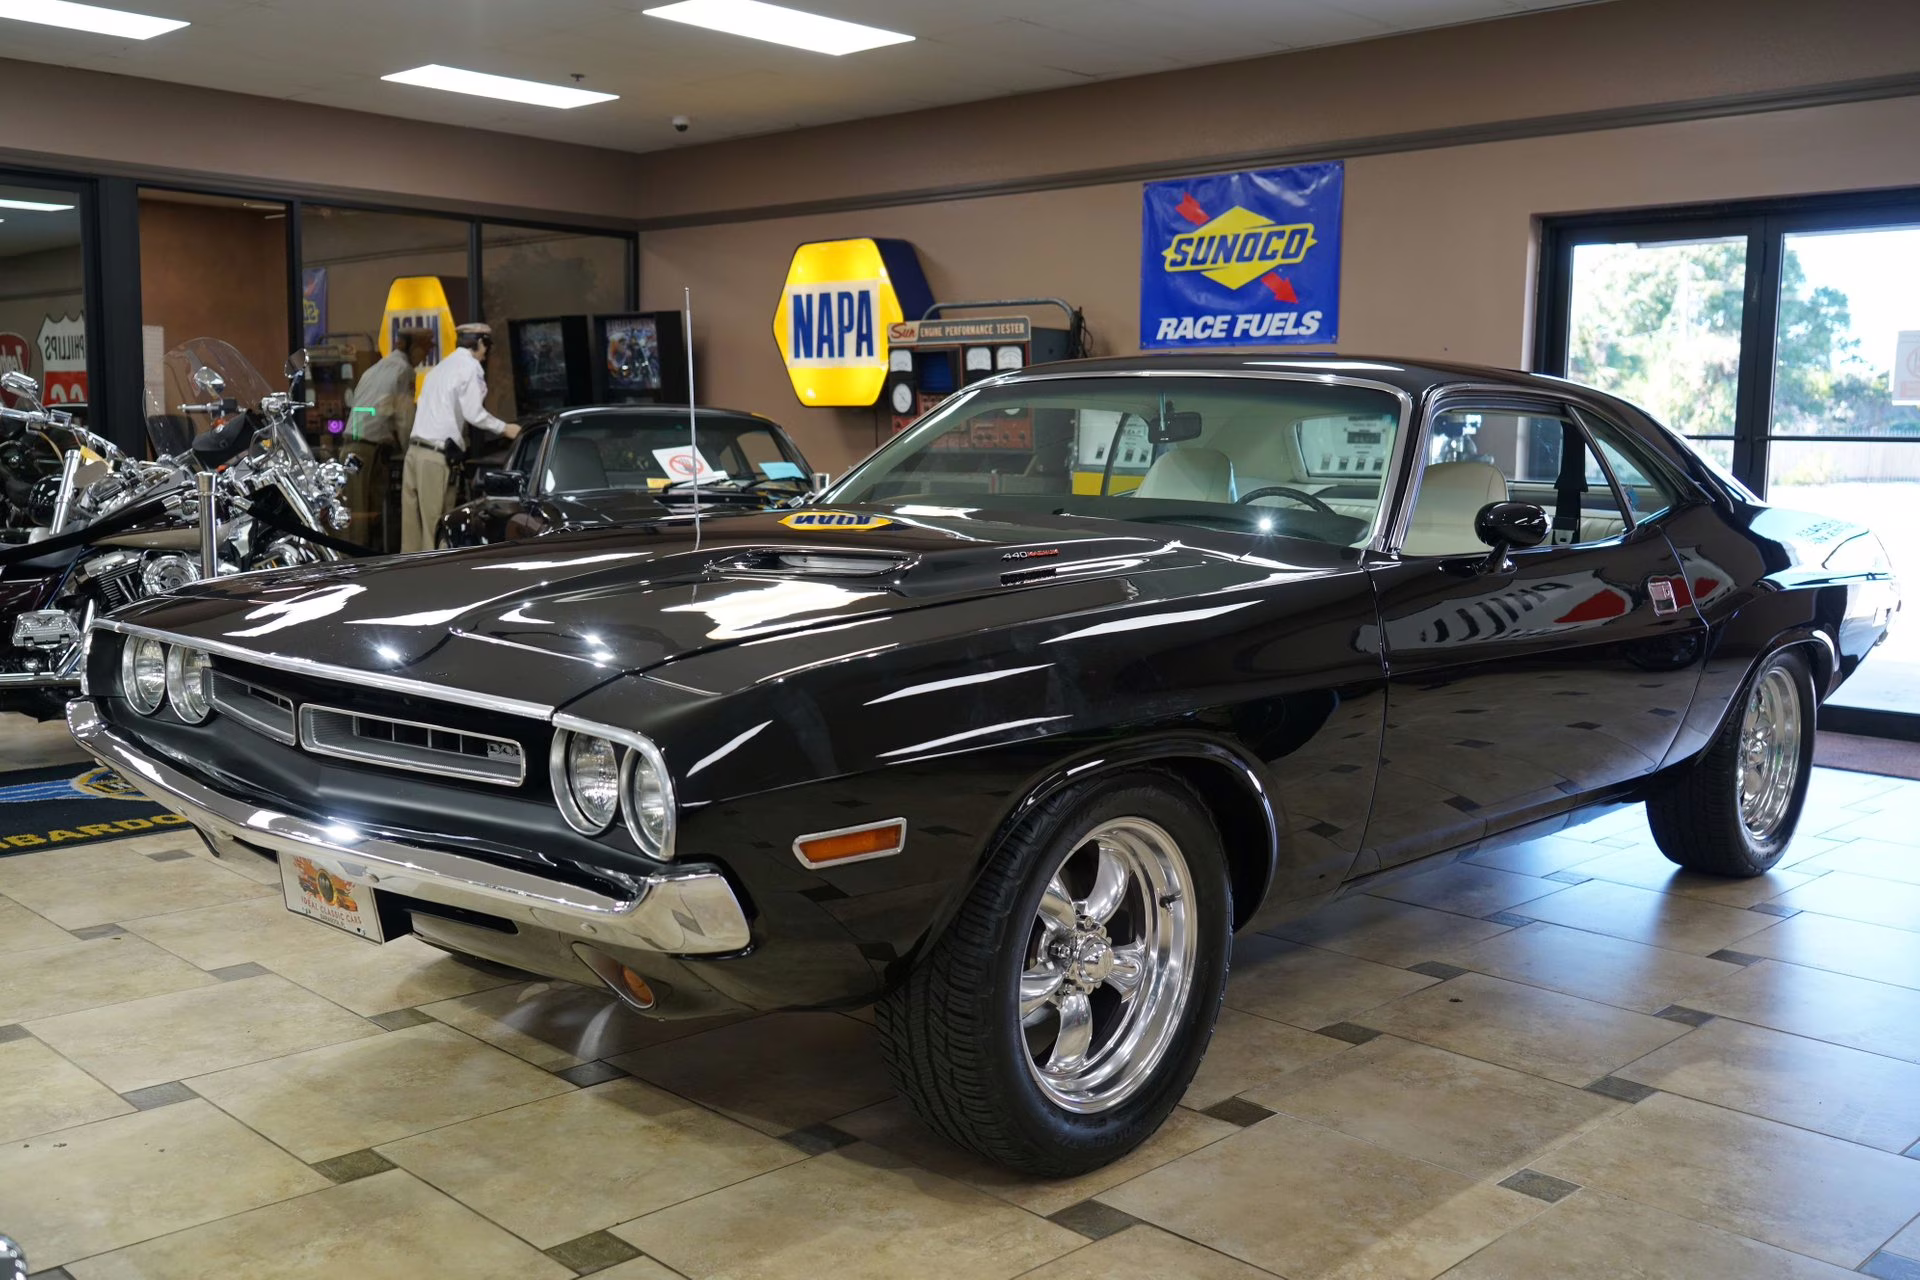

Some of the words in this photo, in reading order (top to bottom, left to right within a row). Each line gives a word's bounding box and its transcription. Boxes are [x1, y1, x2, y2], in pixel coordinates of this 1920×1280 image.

[1168, 228, 1310, 267] SUNOCO
[792, 290, 874, 359] NAPA
[920, 327, 943, 338] ENGINE
[944, 325, 993, 337] PERFORMANCE
[996, 322, 1025, 335] TESTER
[1155, 315, 1232, 340] RACE
[1232, 310, 1322, 338] FUELS
[1001, 550, 1028, 560] 440
[0, 813, 190, 849] BARDO
[301, 895, 319, 911] IDEAL
[320, 904, 345, 921] CLASSIC
[346, 913, 362, 925] CARS
